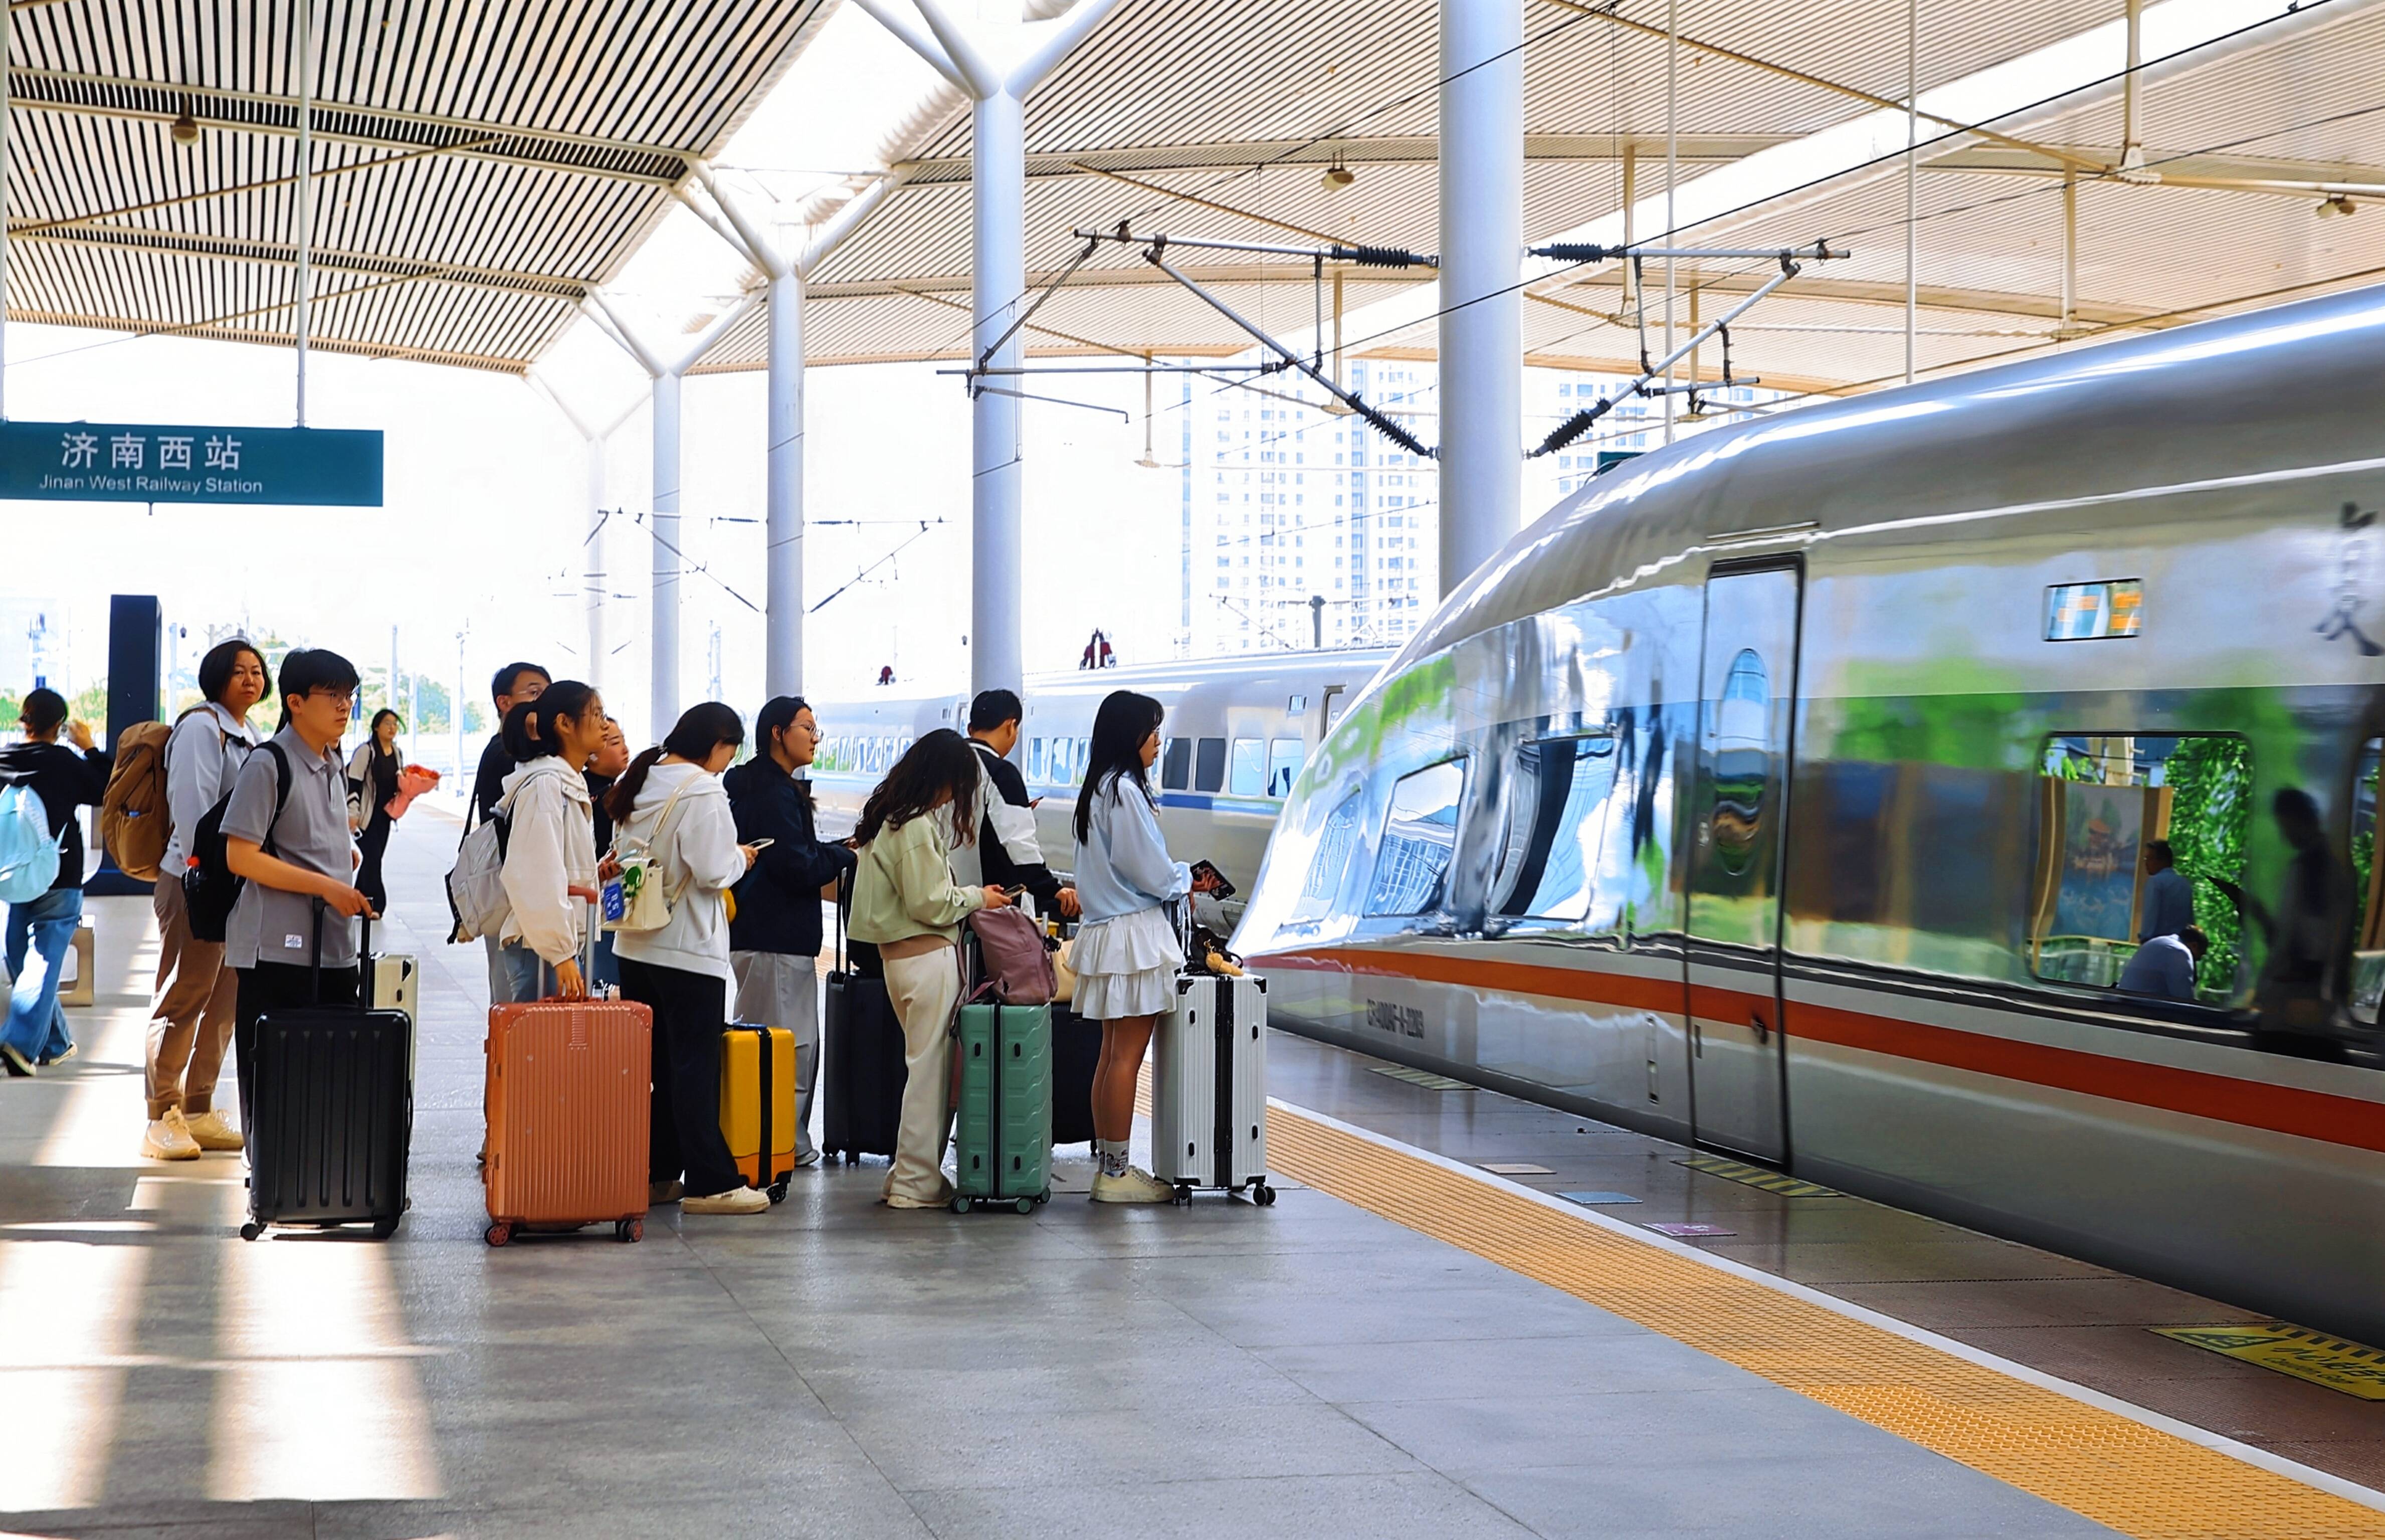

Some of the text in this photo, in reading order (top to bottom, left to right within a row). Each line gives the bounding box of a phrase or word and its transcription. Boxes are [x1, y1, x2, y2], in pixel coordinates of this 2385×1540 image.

[61, 432, 242, 470] 济南西站
[40, 475, 262, 494] Jinan West Railway Station
